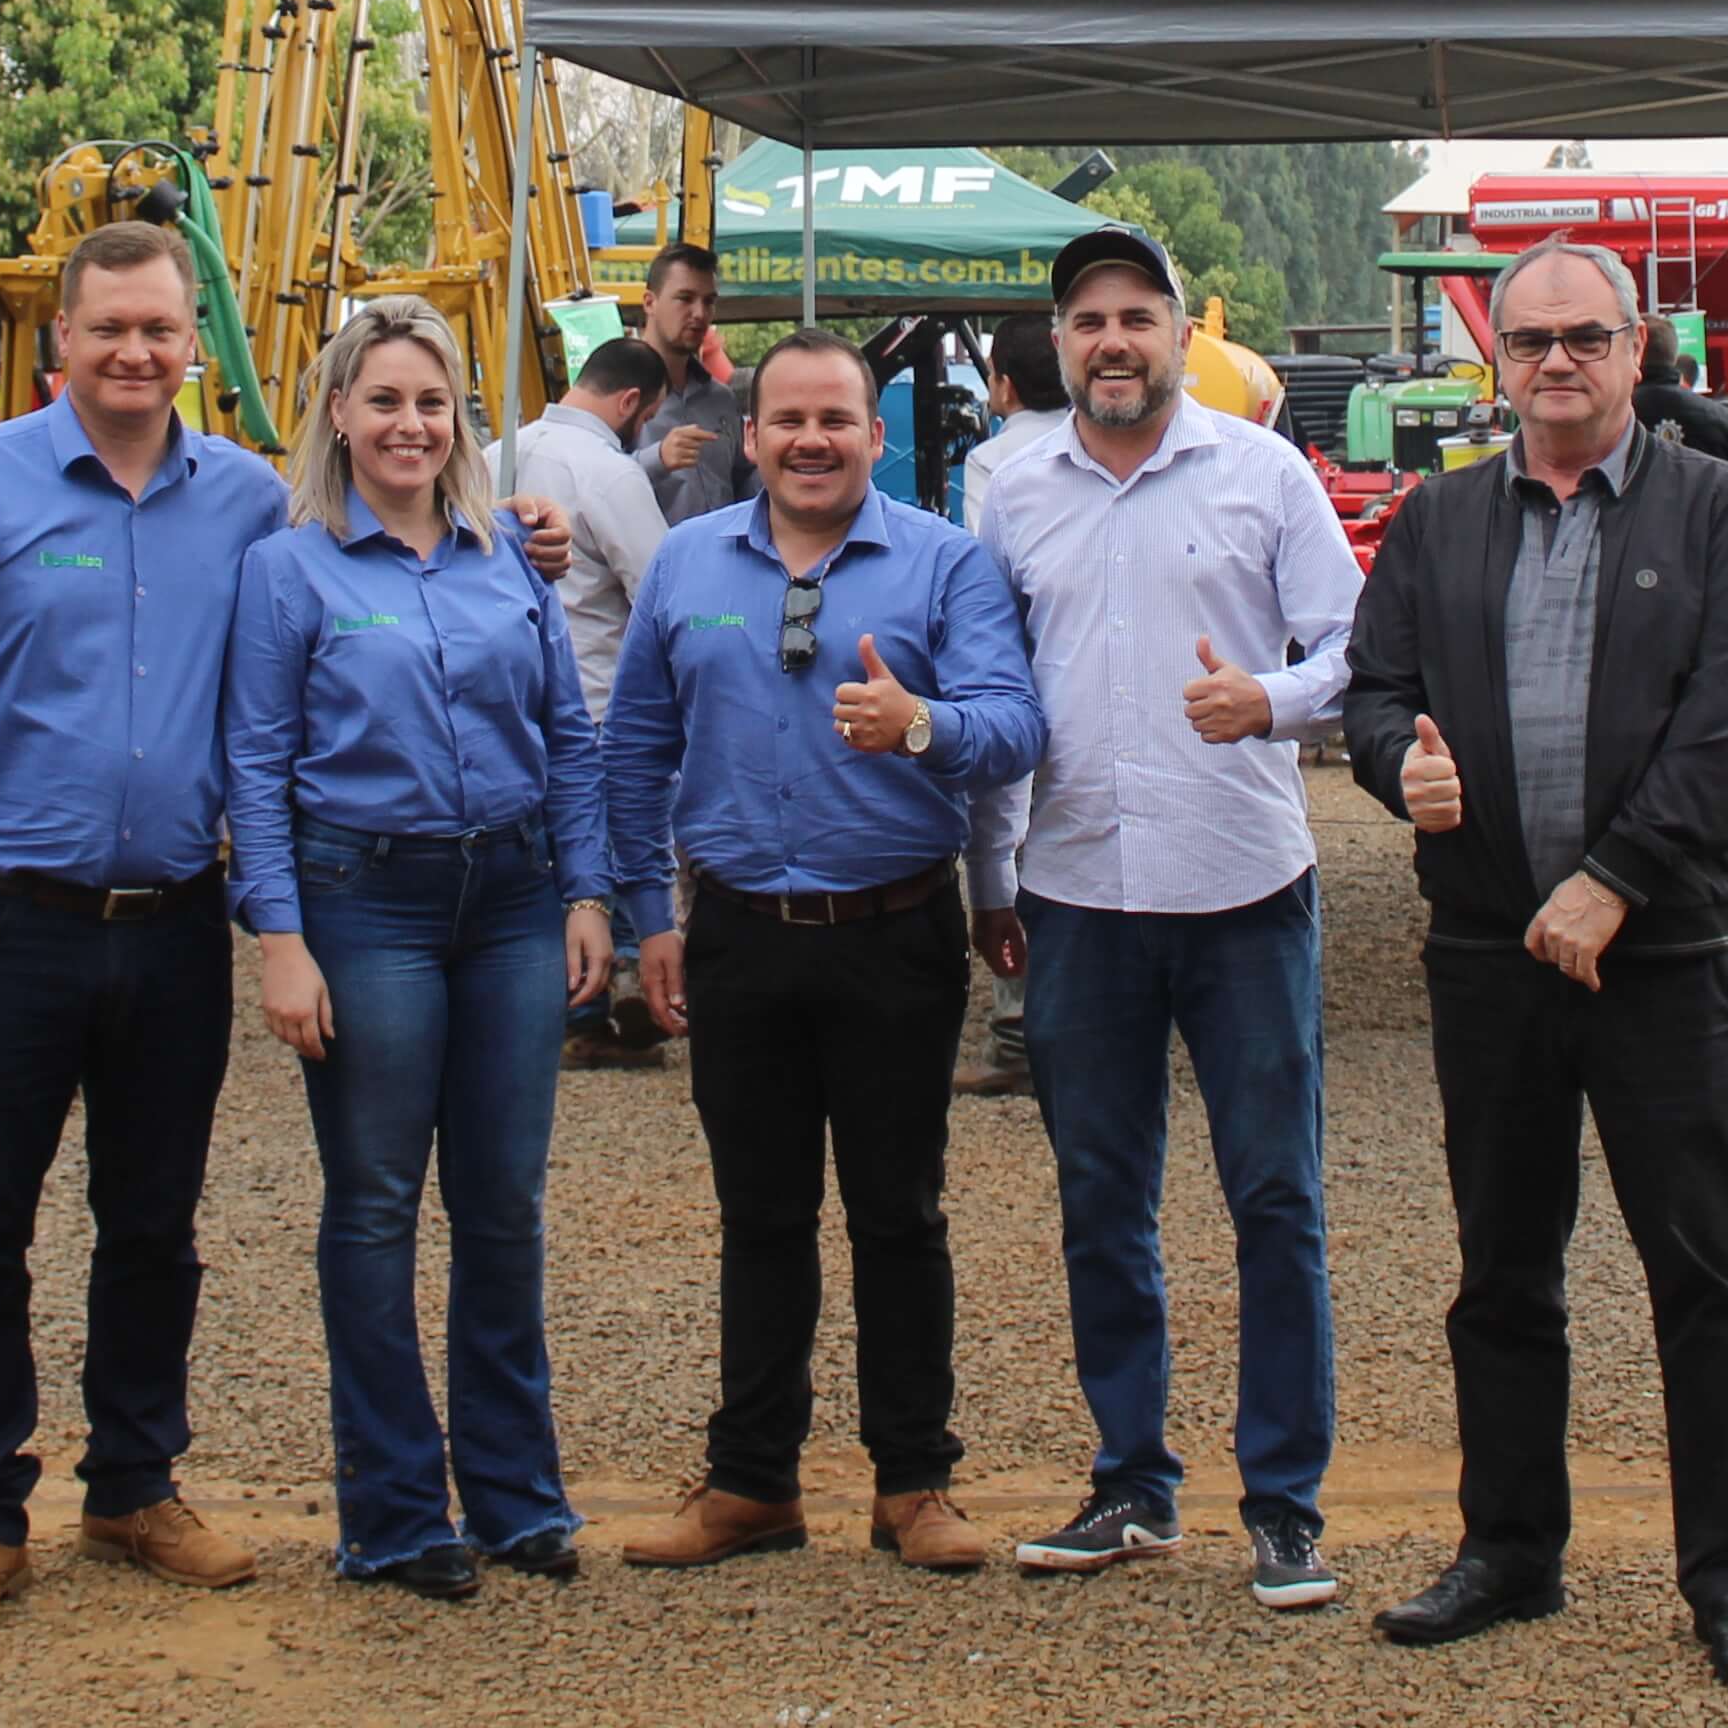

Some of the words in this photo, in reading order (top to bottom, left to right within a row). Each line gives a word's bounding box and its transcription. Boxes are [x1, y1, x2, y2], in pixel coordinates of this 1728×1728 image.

[775, 166, 995, 209] TMF
[1479, 206, 1548, 220] INDUSTRIAL
[1552, 205, 1594, 218] BECKER
